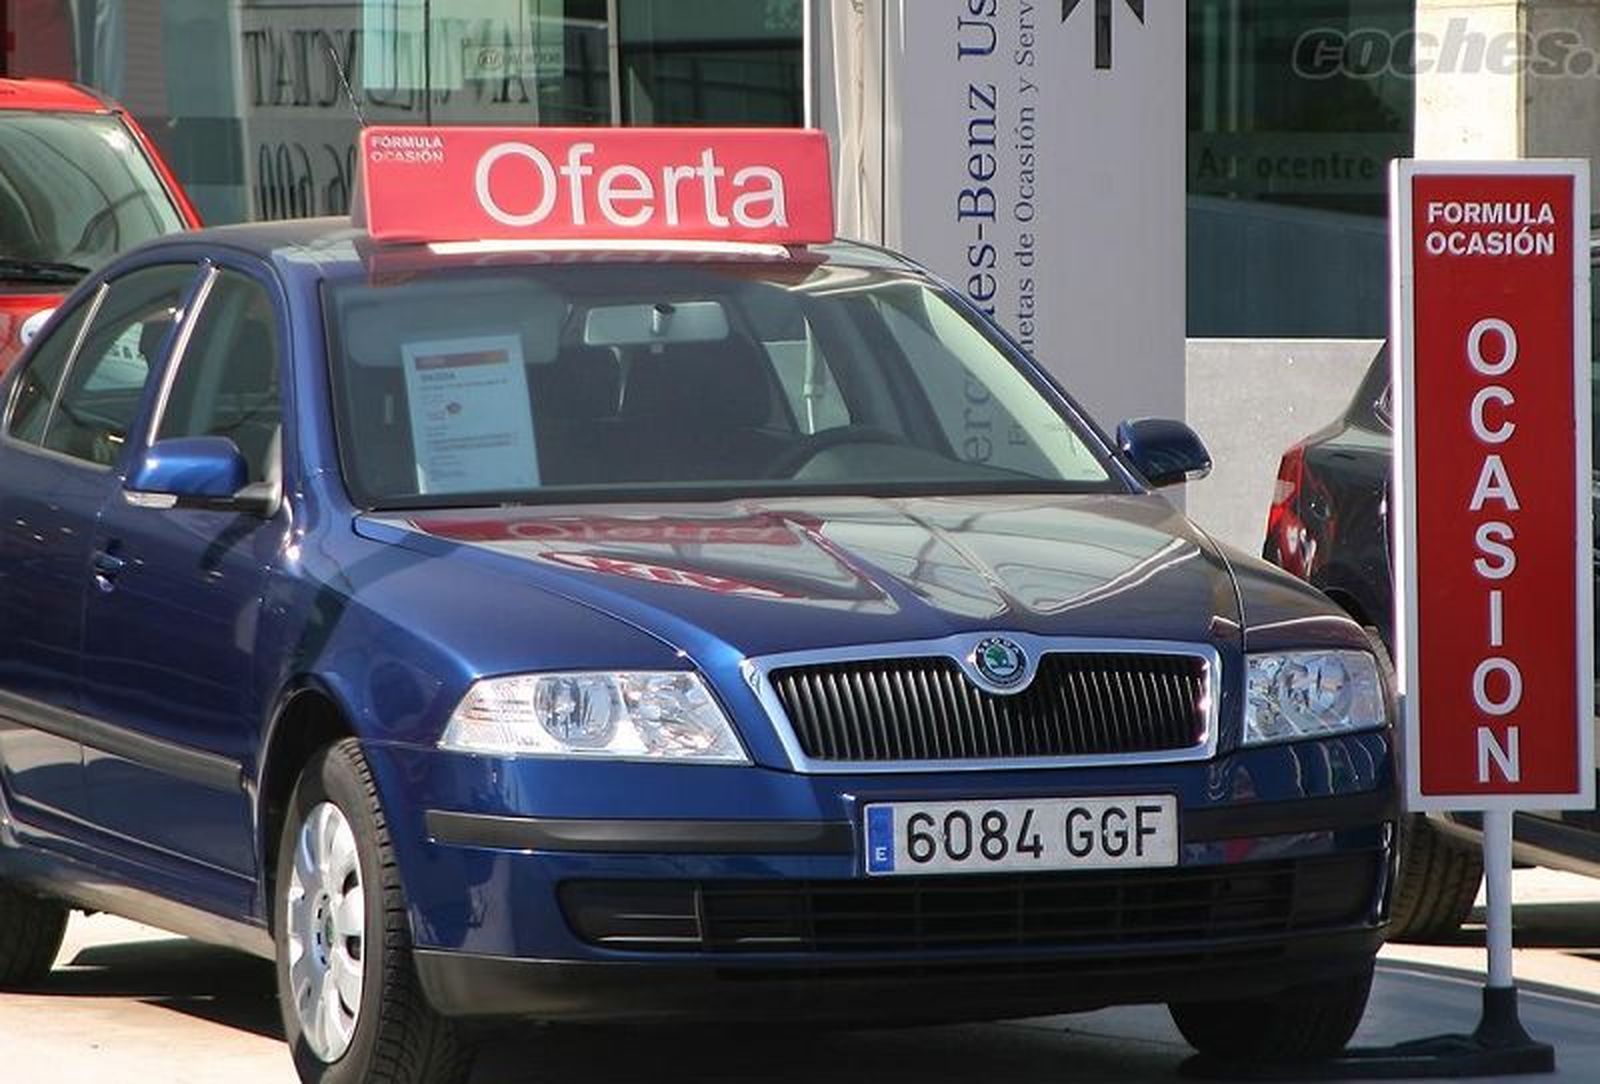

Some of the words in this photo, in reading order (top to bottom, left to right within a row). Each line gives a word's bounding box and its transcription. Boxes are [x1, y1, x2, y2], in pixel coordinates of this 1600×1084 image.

[1019, 76, 1038, 93] y
[1013, 107, 1035, 222] Ocasión
[475, 141, 791, 229] Oferta
[1427, 202, 1556, 224] FORMULA
[1014, 233, 1034, 267] de
[1426, 226, 1556, 255] OCASIÓN
[1466, 317, 1523, 784] OCASION
[906, 808, 1045, 863] 6084
[1065, 804, 1163, 858] GGF
[875, 847, 887, 861] E
